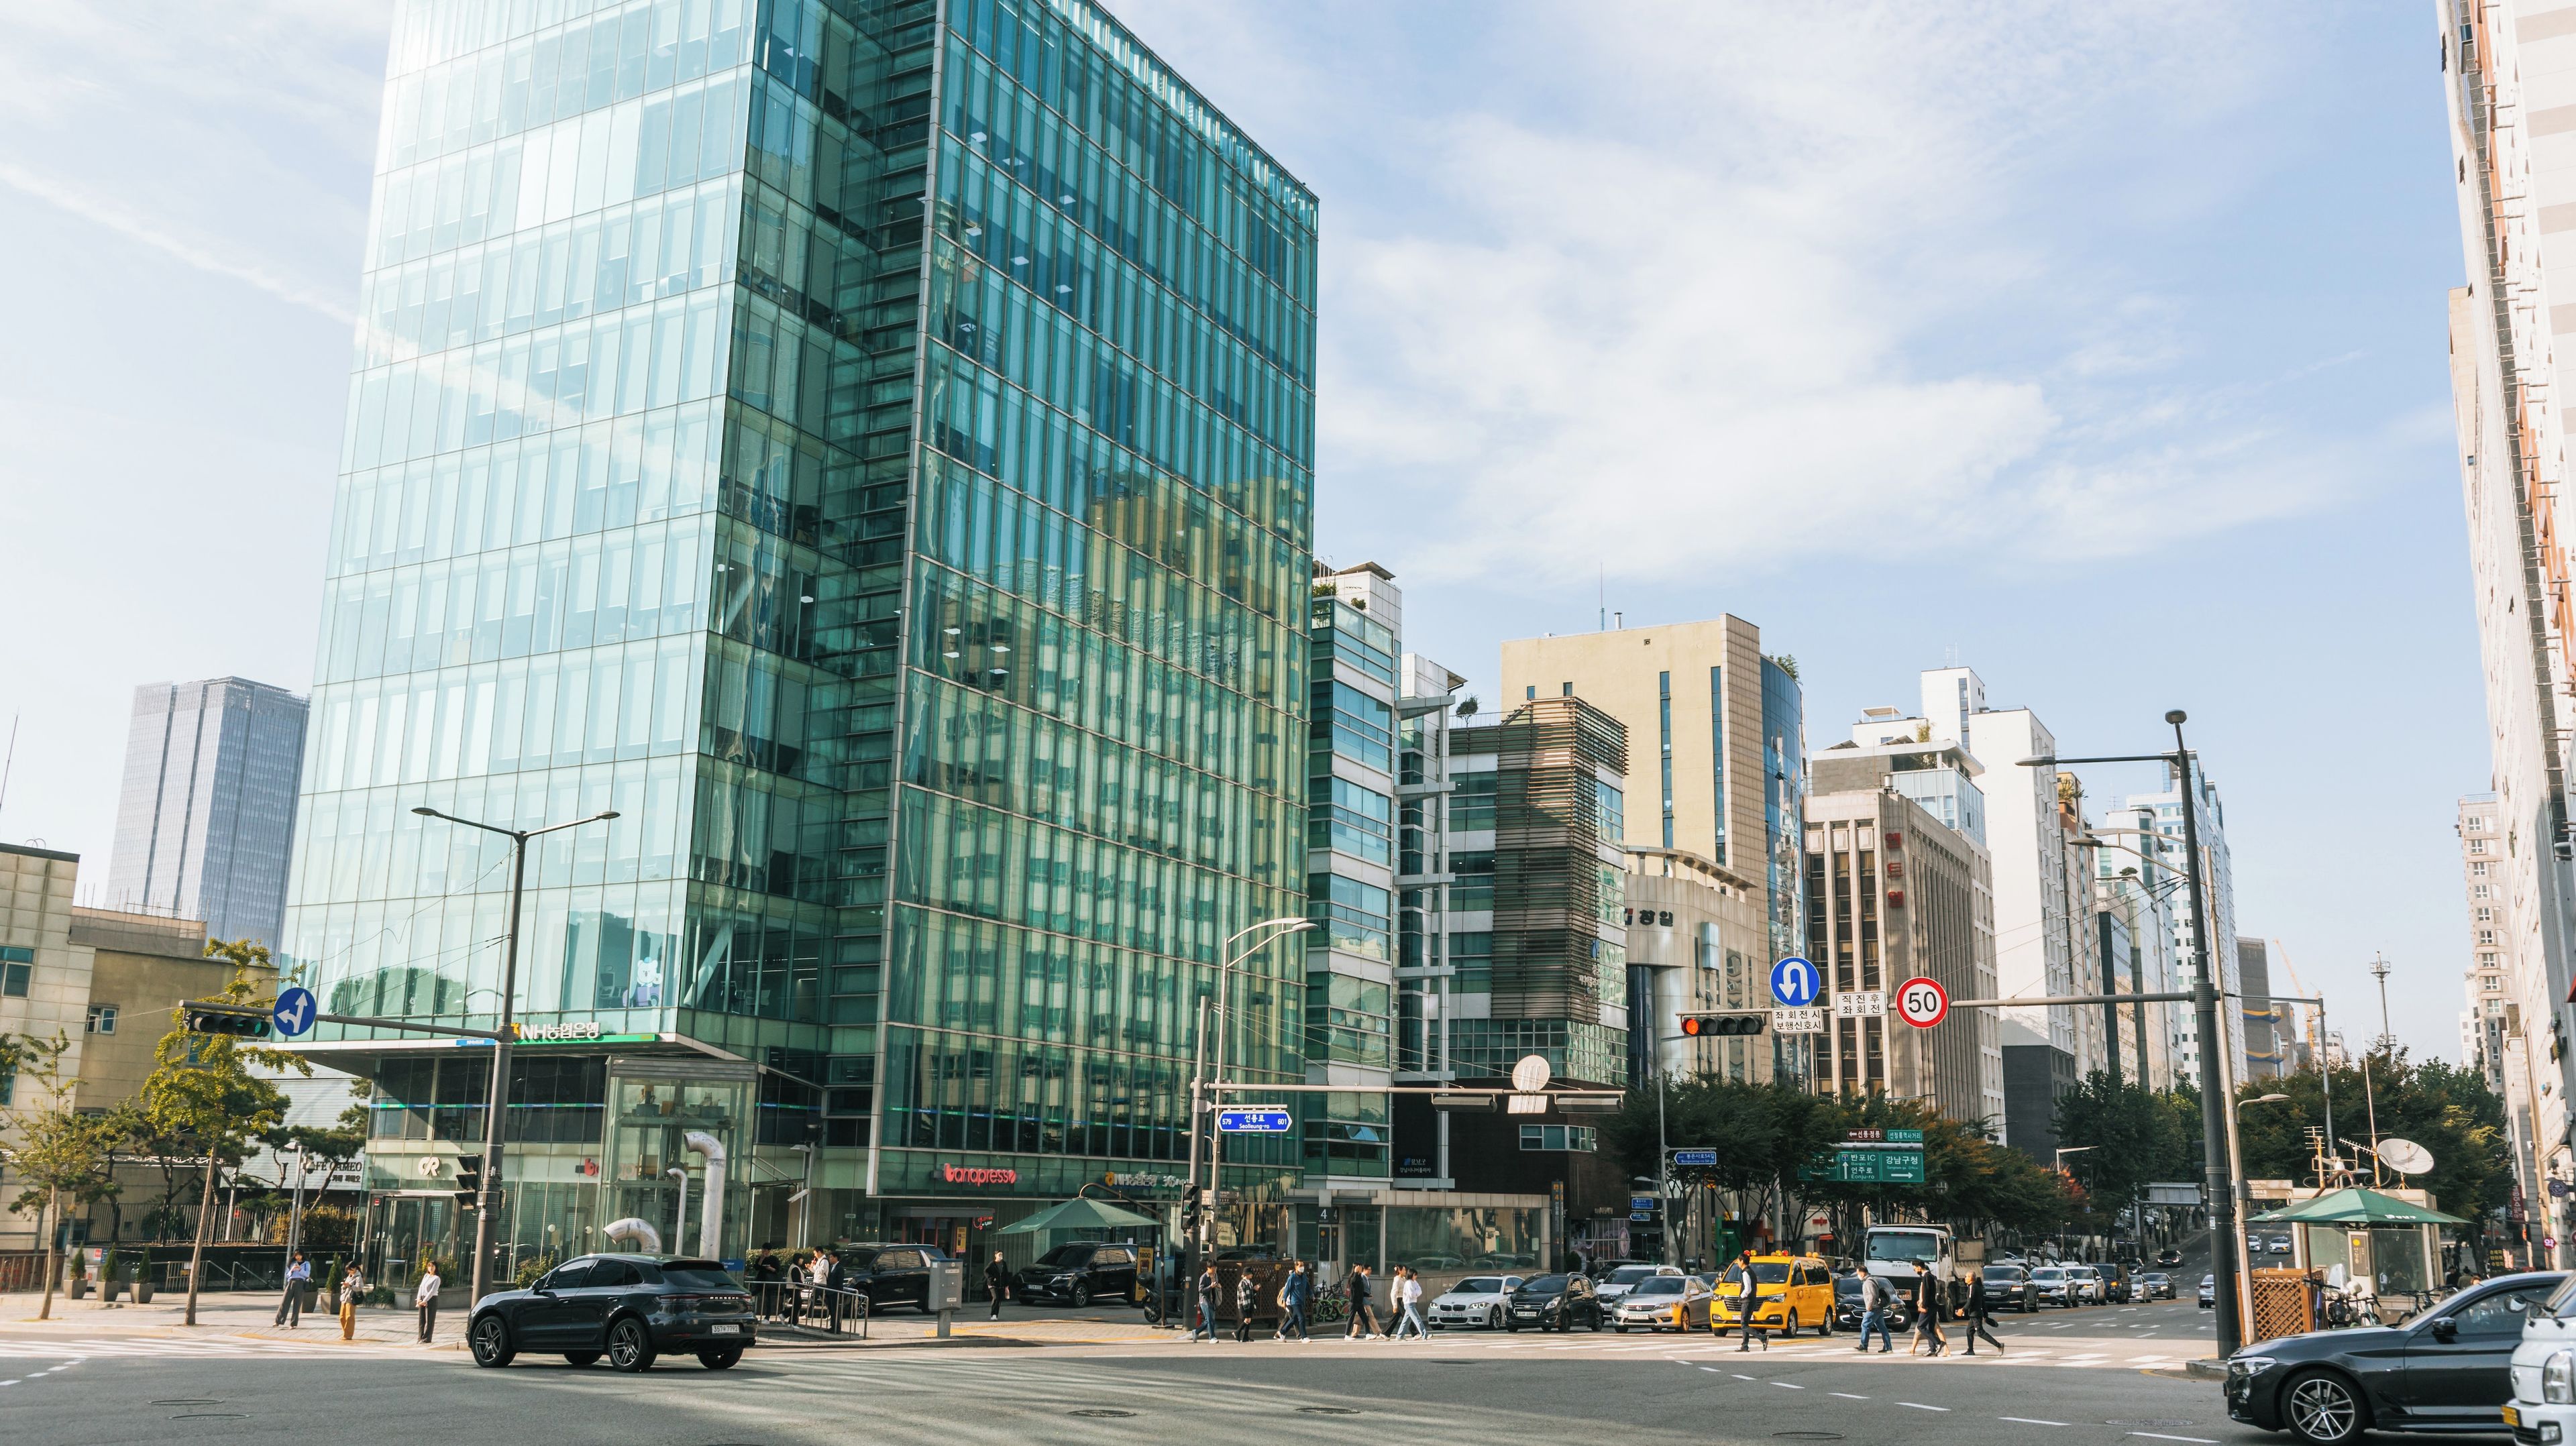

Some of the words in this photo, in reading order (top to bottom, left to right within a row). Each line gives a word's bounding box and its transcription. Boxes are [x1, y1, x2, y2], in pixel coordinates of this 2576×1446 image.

[1908, 991, 1937, 1013] 50
[521, 1021, 600, 1040] NH농협은행
[1244, 1114, 1265, 1123] 선릉로
[1886, 1156, 1919, 1165] 강남구청
[1320, 1209, 1328, 1219] 4
[1334, 1209, 1338, 1219] 4
